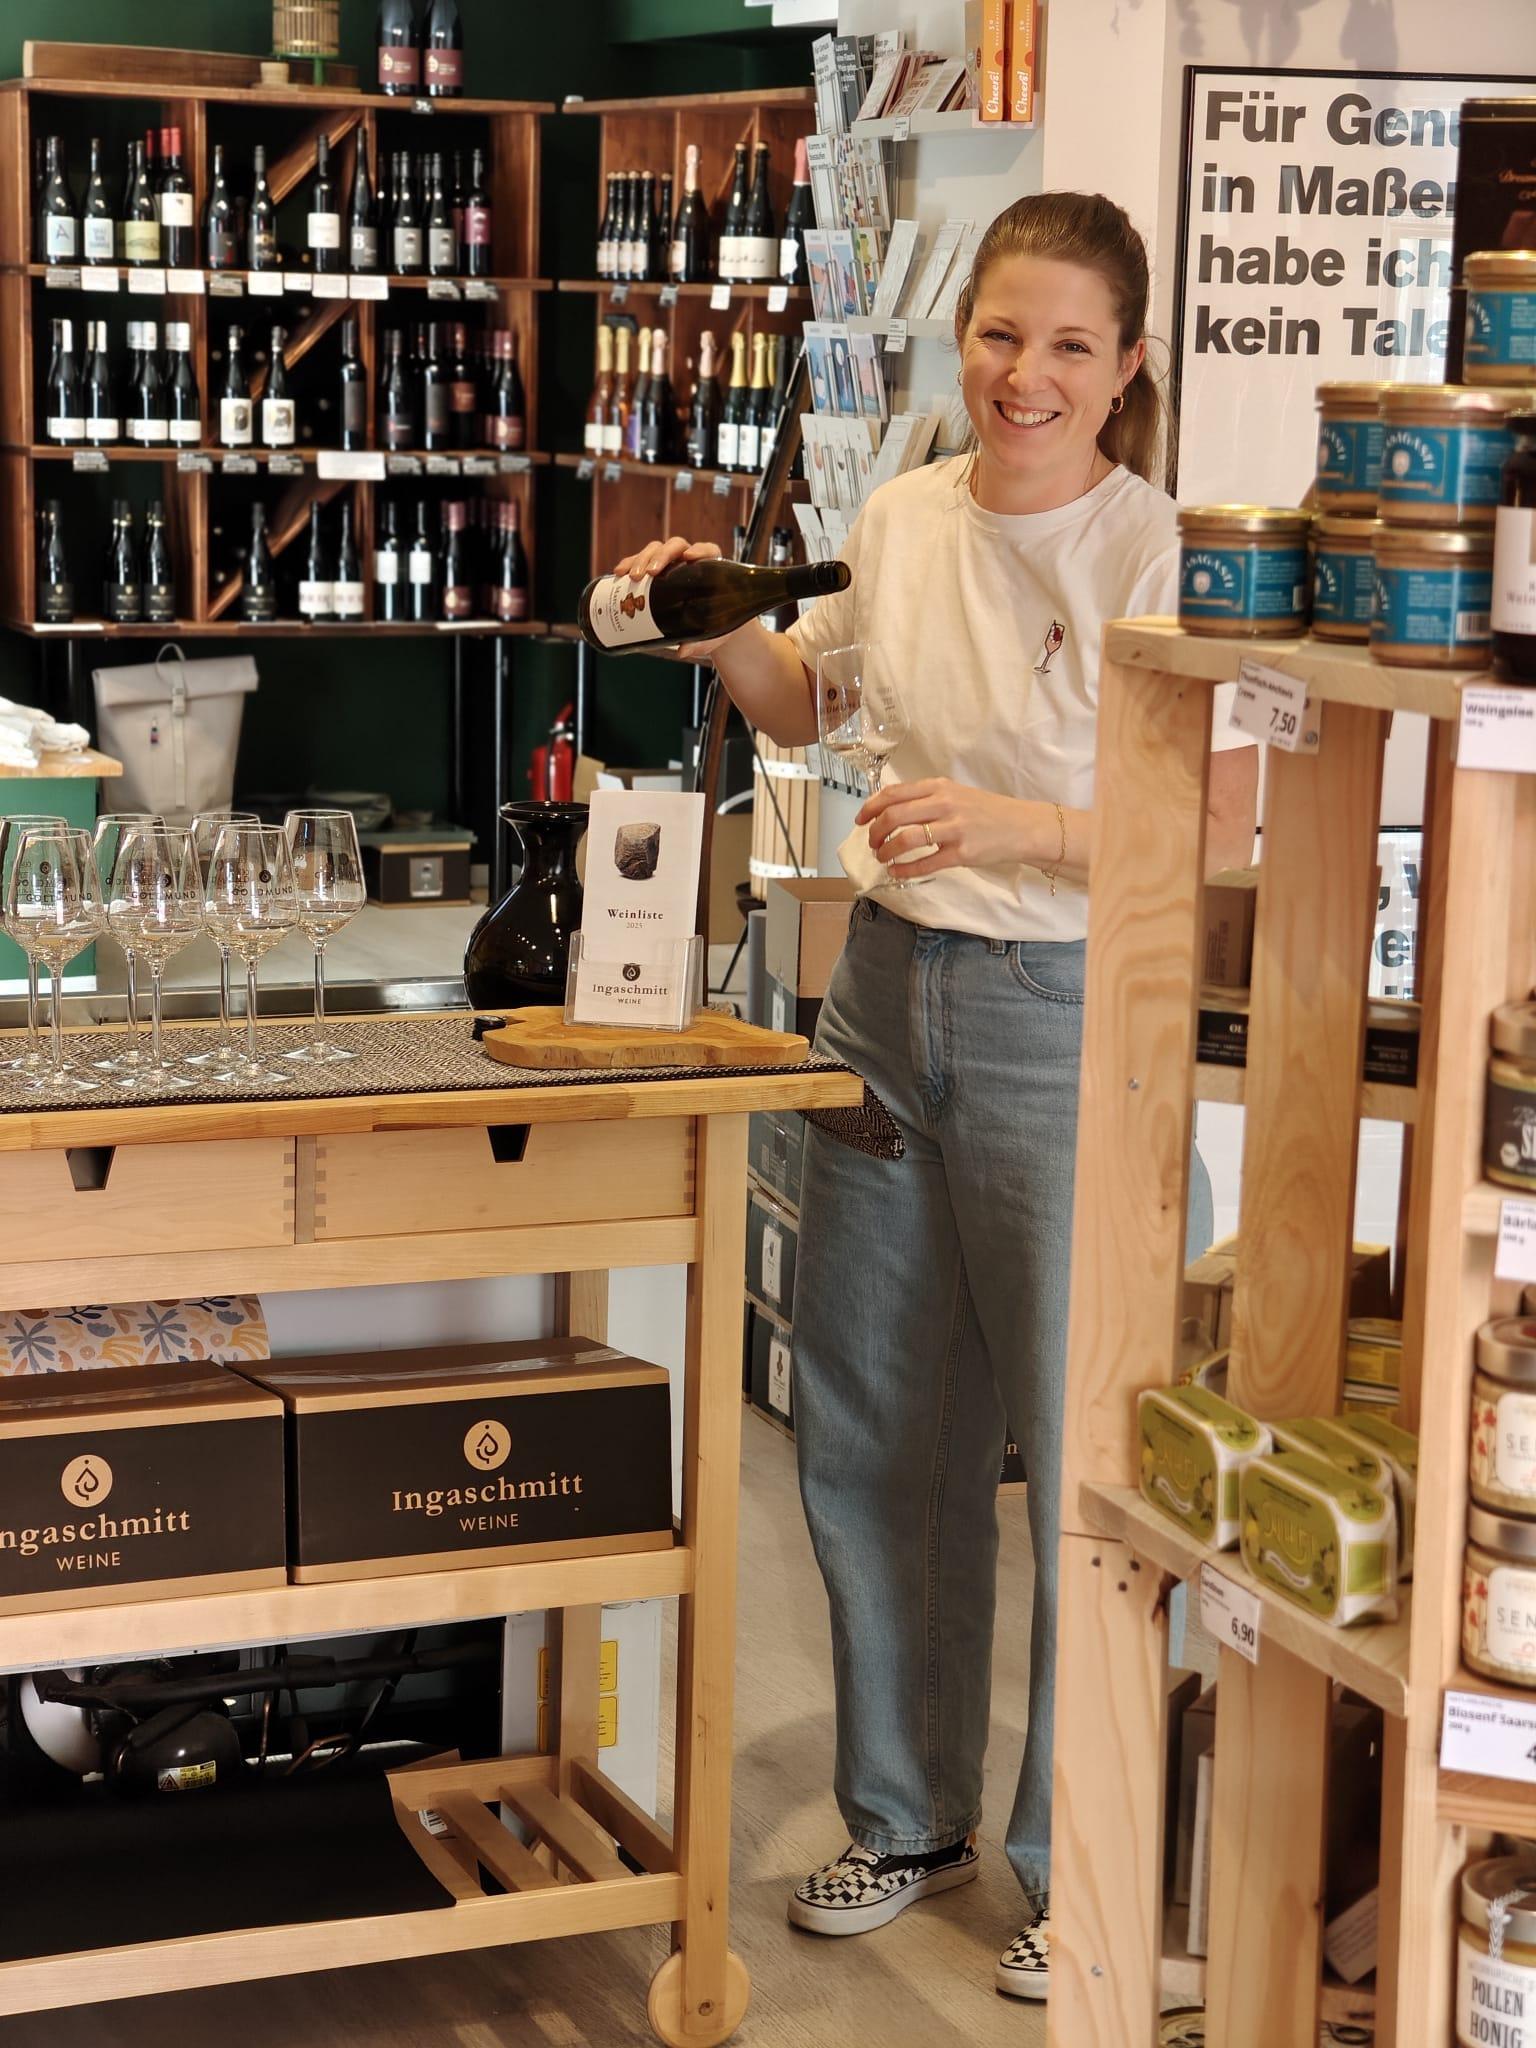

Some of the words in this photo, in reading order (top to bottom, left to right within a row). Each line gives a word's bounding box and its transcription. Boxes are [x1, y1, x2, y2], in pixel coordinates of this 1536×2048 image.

[986, 70, 1000, 114] Cheers!
[1015, 70, 1029, 114] Cheers!
[1205, 90, 1306, 143] Für
[1201, 163, 1255, 213] in
[1198, 234, 1345, 287] habe
[1366, 238, 1451, 288] ich
[1194, 305, 1321, 356] kein
[1269, 706, 1297, 735] 7,50
[1465, 703, 1534, 719] Weingelee
[132, 890, 196, 901] GOLMUND
[232, 886, 294, 897] GODMUND
[607, 908, 664, 921] Weinliste
[592, 984, 668, 996] Ingaschmitt
[1505, 1432, 1536, 1453] SE
[392, 1470, 584, 1519] Ingaschmitt
[459, 1512, 519, 1532] WEINE
[56, 1551, 121, 1571] WEINE
[1231, 1616, 1255, 1647] 6,90
[1448, 1705, 1497, 1723] Biosenf
[1471, 1976, 1525, 2018] POLLEN
[1470, 2009, 1523, 2048] HONIG
